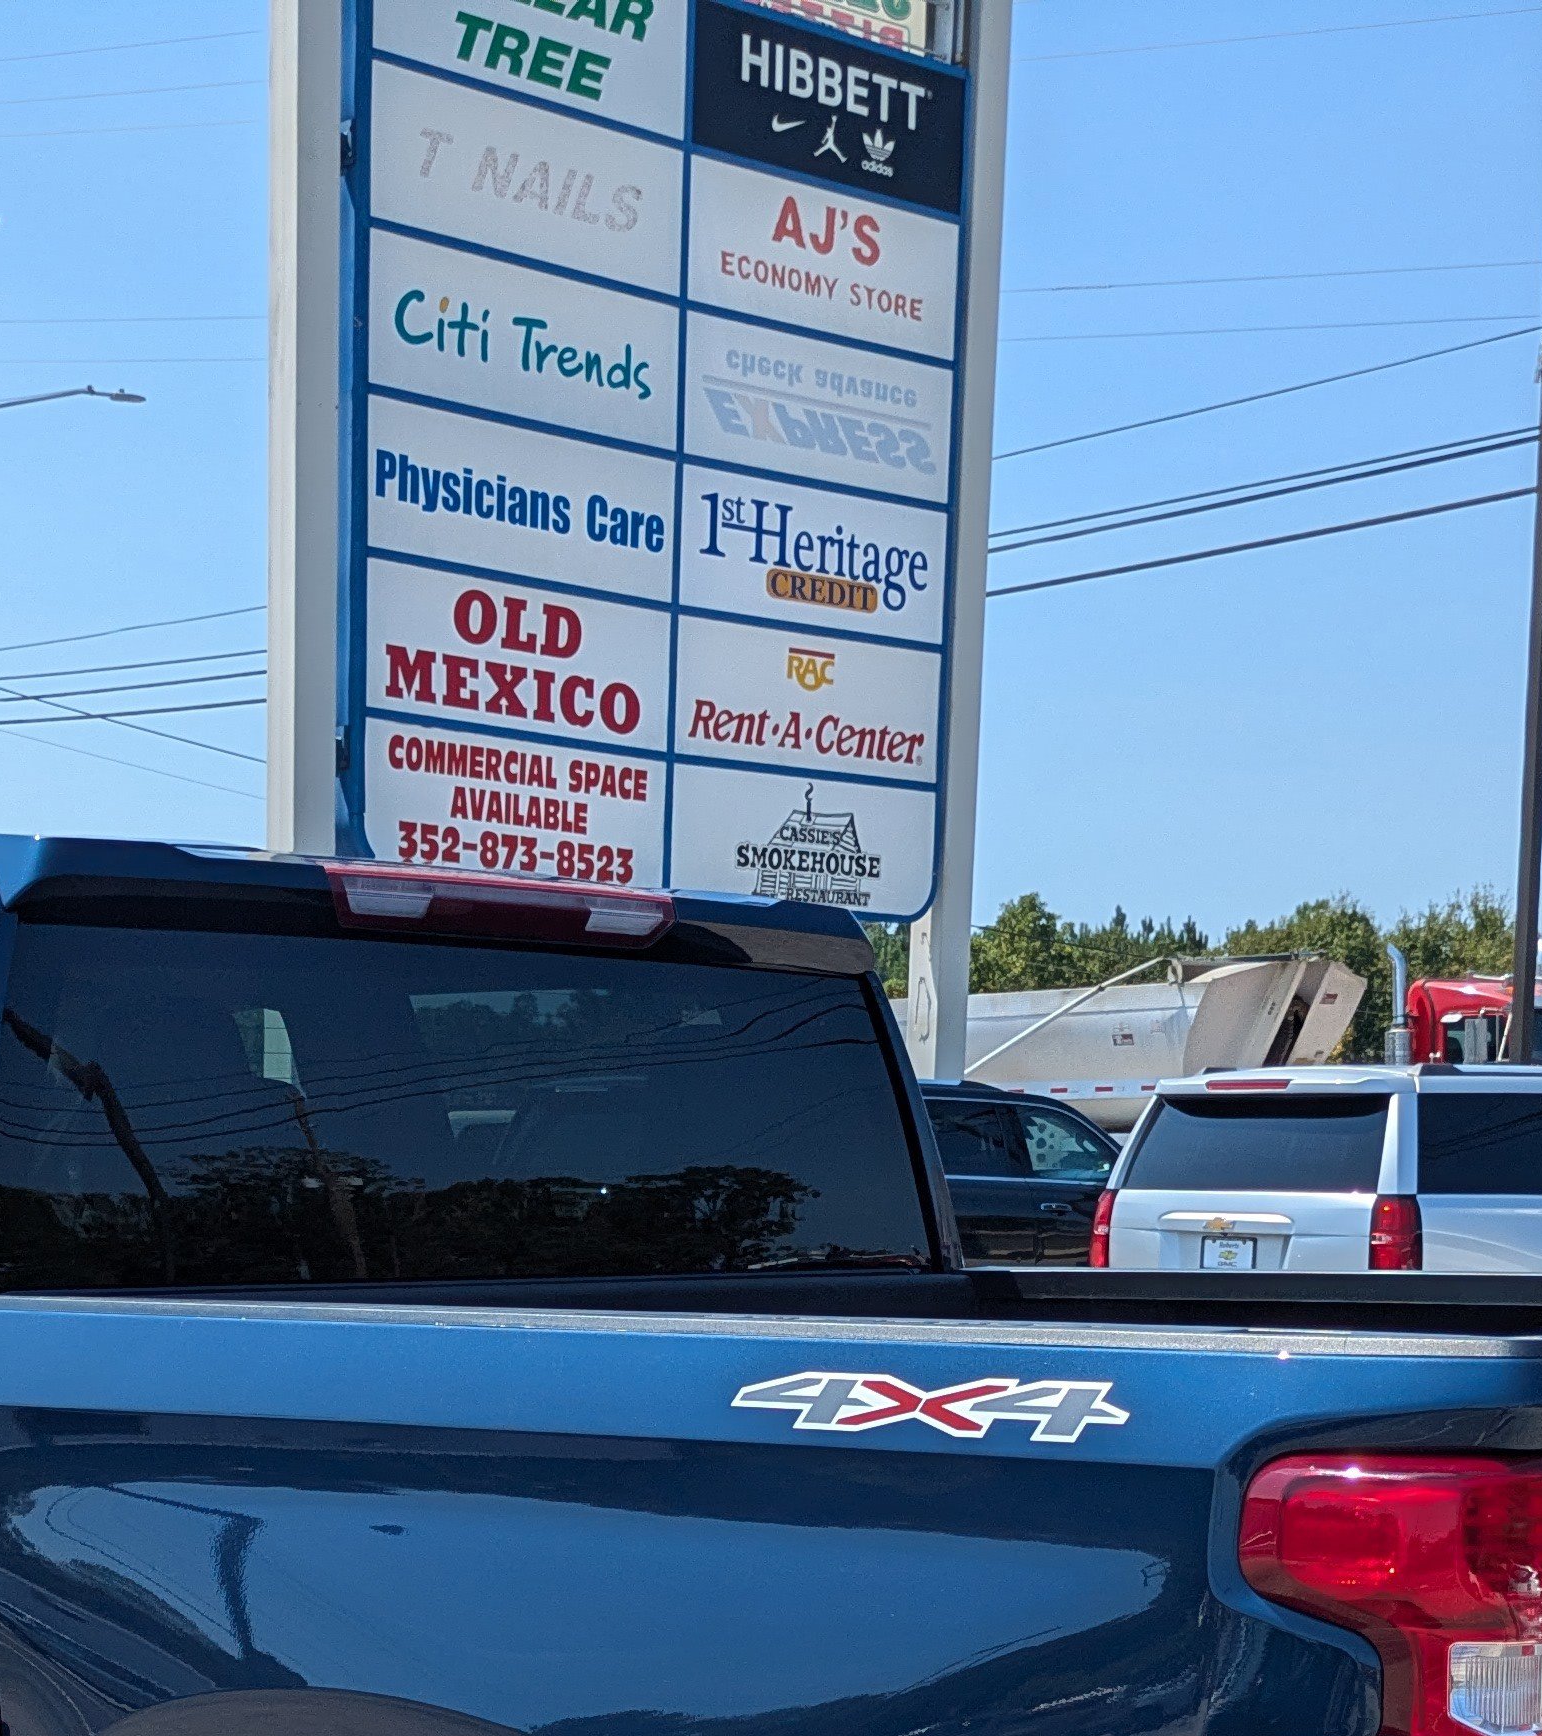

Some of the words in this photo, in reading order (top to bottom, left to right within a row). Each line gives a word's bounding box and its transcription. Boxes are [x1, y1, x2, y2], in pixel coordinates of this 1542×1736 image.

[455, 10, 612, 101] TREE
[741, 33, 926, 131] HIBBETT
[420, 127, 454, 178] T
[471, 146, 643, 232] NAILS
[771, 196, 881, 267] AJ'S
[720, 250, 840, 300] ECONOMY
[850, 283, 923, 322] STORE
[394, 289, 490, 363] Citi
[512, 316, 652, 401] Trends
[375, 448, 572, 535] Physicians
[586, 494, 665, 553] Care
[699, 492, 746, 558] 1st
[749, 499, 929, 612] Heritage
[453, 589, 582, 659] OLD
[771, 572, 876, 611] CREDIT
[385, 643, 641, 735] MEXICO
[786, 654, 836, 692] RAC
[388, 734, 557, 790] COMMERCIAL
[568, 759, 649, 802] SPACE
[450, 786, 589, 836] AVAILABLE
[398, 820, 634, 885] 352-873-8523
[736, 843, 881, 879] SMOKEHOUSE
[786, 887, 872, 908] RESTAURANT
